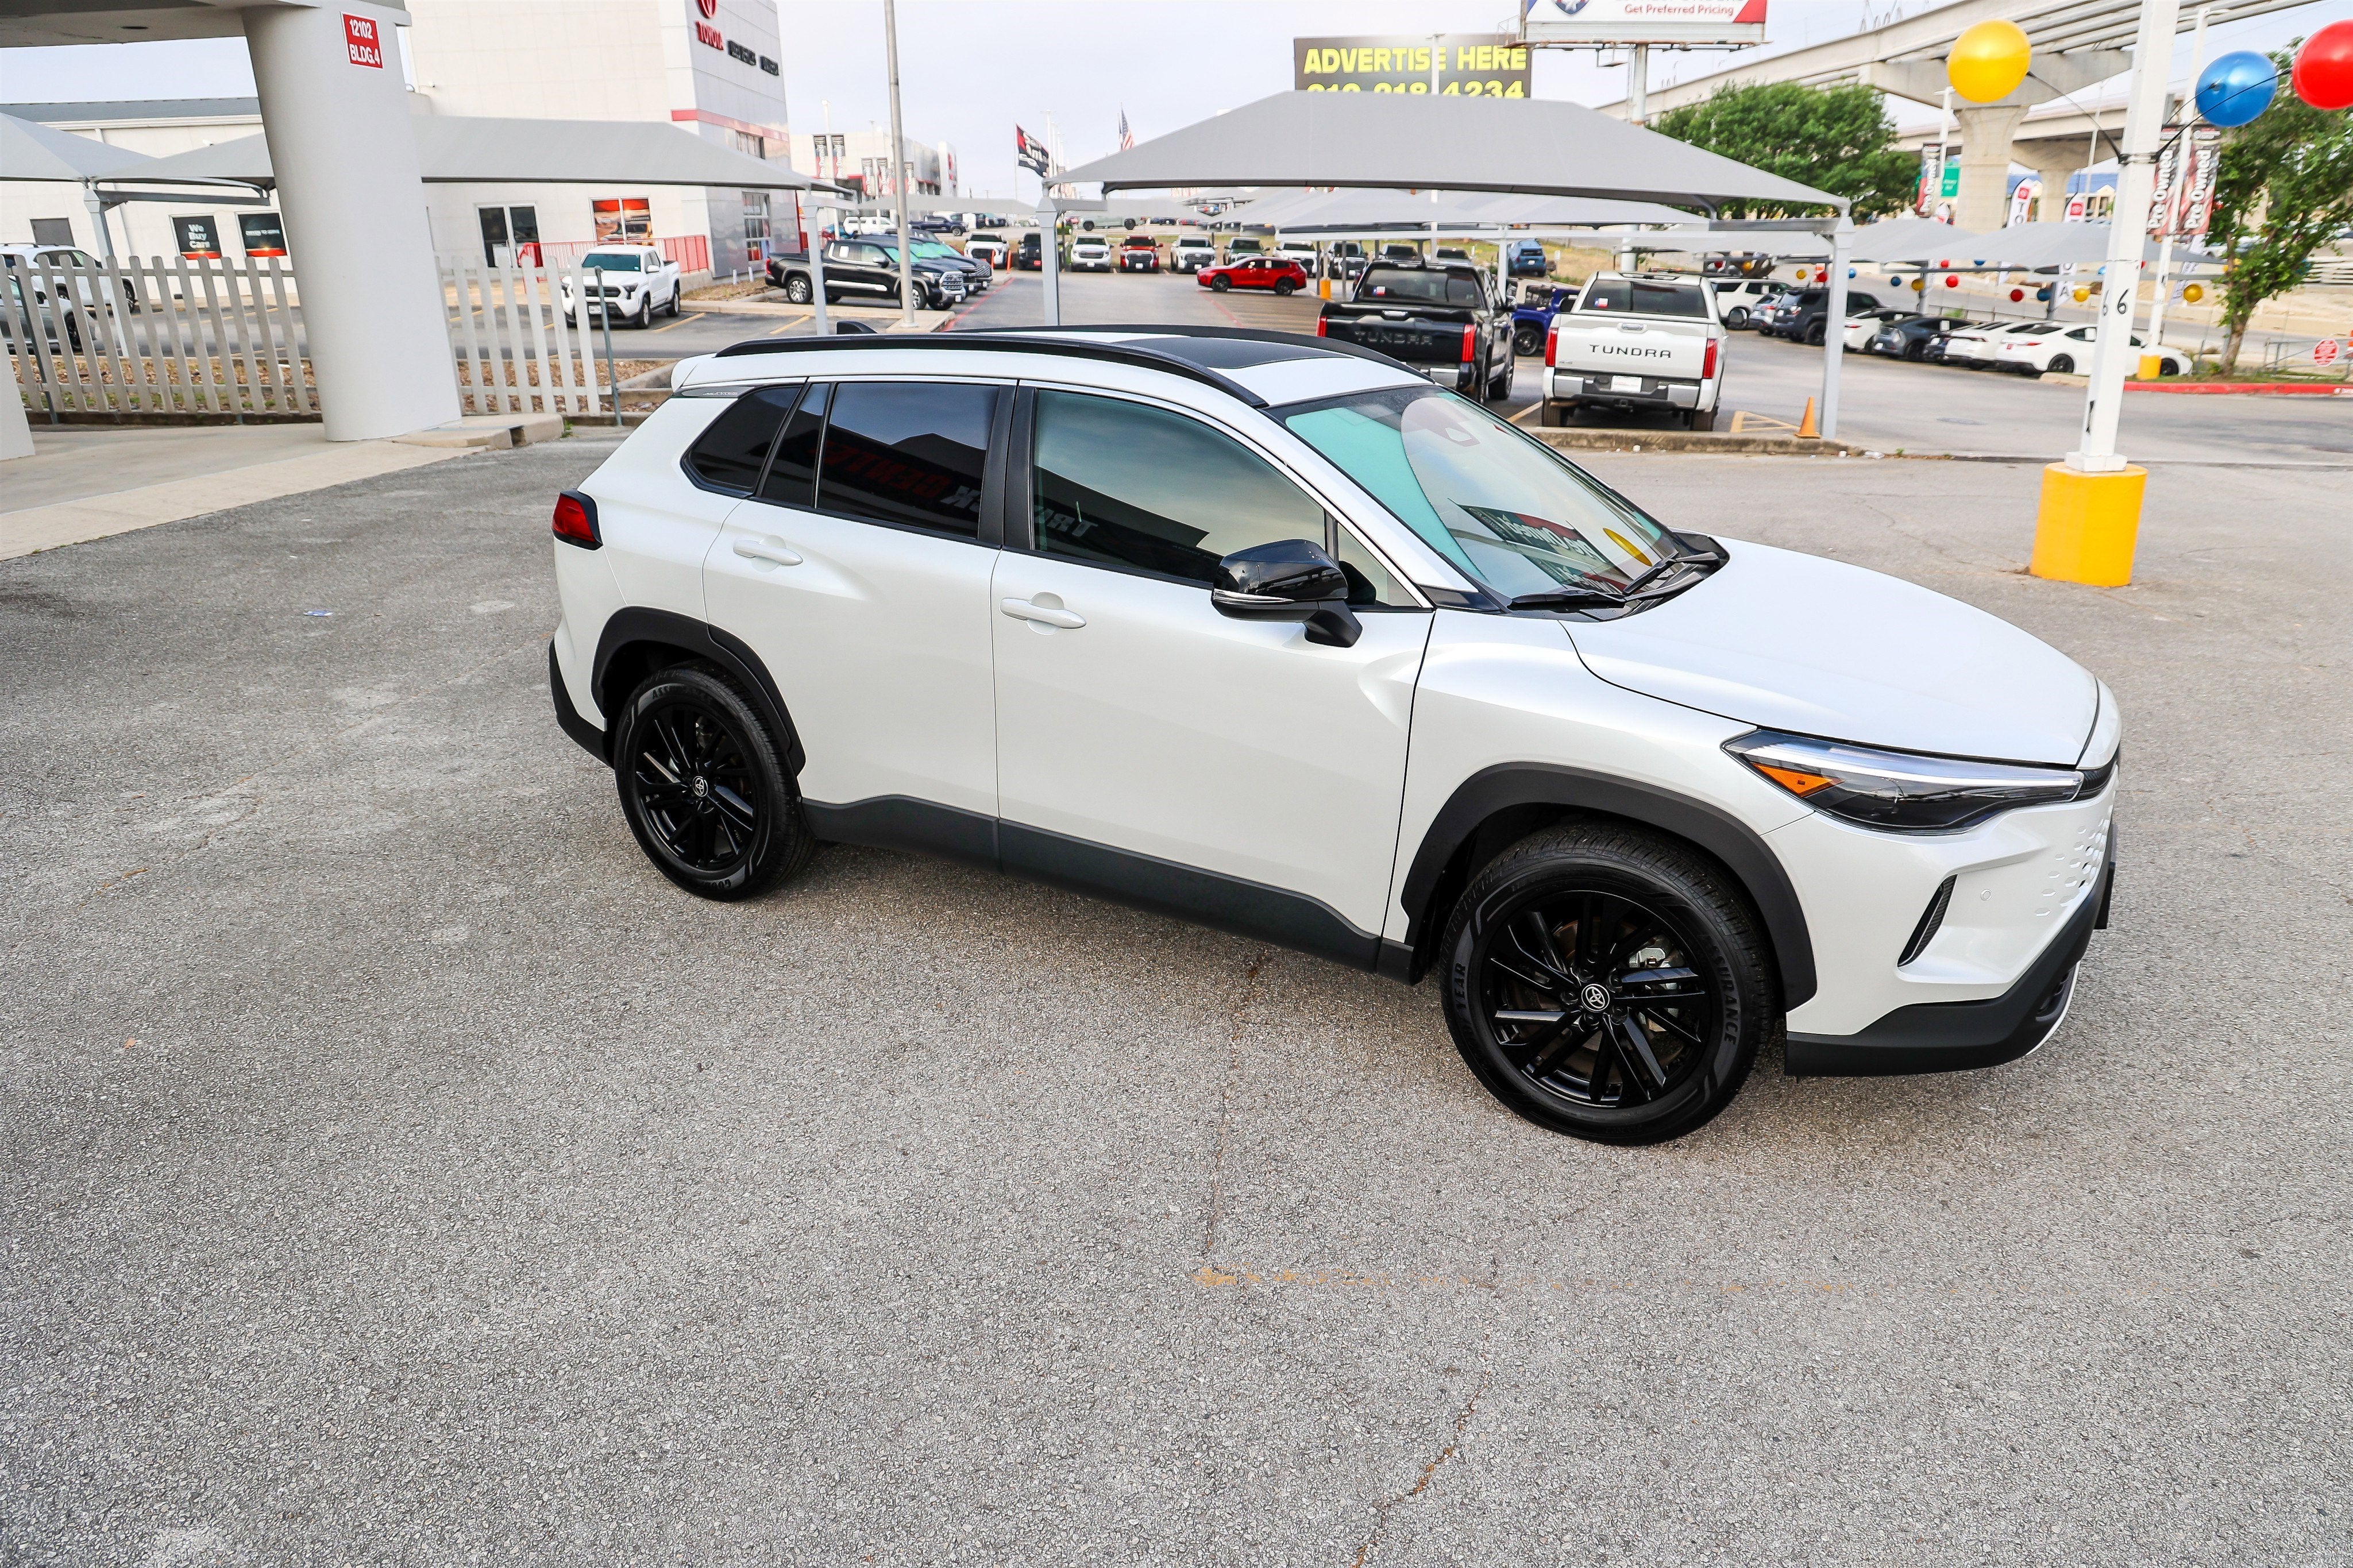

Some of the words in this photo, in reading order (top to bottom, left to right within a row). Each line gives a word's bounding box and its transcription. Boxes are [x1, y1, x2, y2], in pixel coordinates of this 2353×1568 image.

[1625, 4, 1643, 14] Get
[1646, 4, 1695, 14] Preferred
[1698, 5, 1734, 16] Pricing
[349, 18, 373, 40] 12102
[696, 21, 724, 51] TOYOTA
[1457, 45, 1527, 71] HERE
[2154, 149, 2174, 201] Owned
[2190, 149, 2212, 201] Owned
[2147, 203, 2165, 229] Pre
[2184, 203, 2203, 229] Pre
[188, 232, 207, 240] Buy
[189, 240, 211, 248] Cars
[2117, 288, 2130, 314] 6
[1355, 331, 1433, 345] TUNDRA
[1590, 344, 1672, 358] TUNDRA
